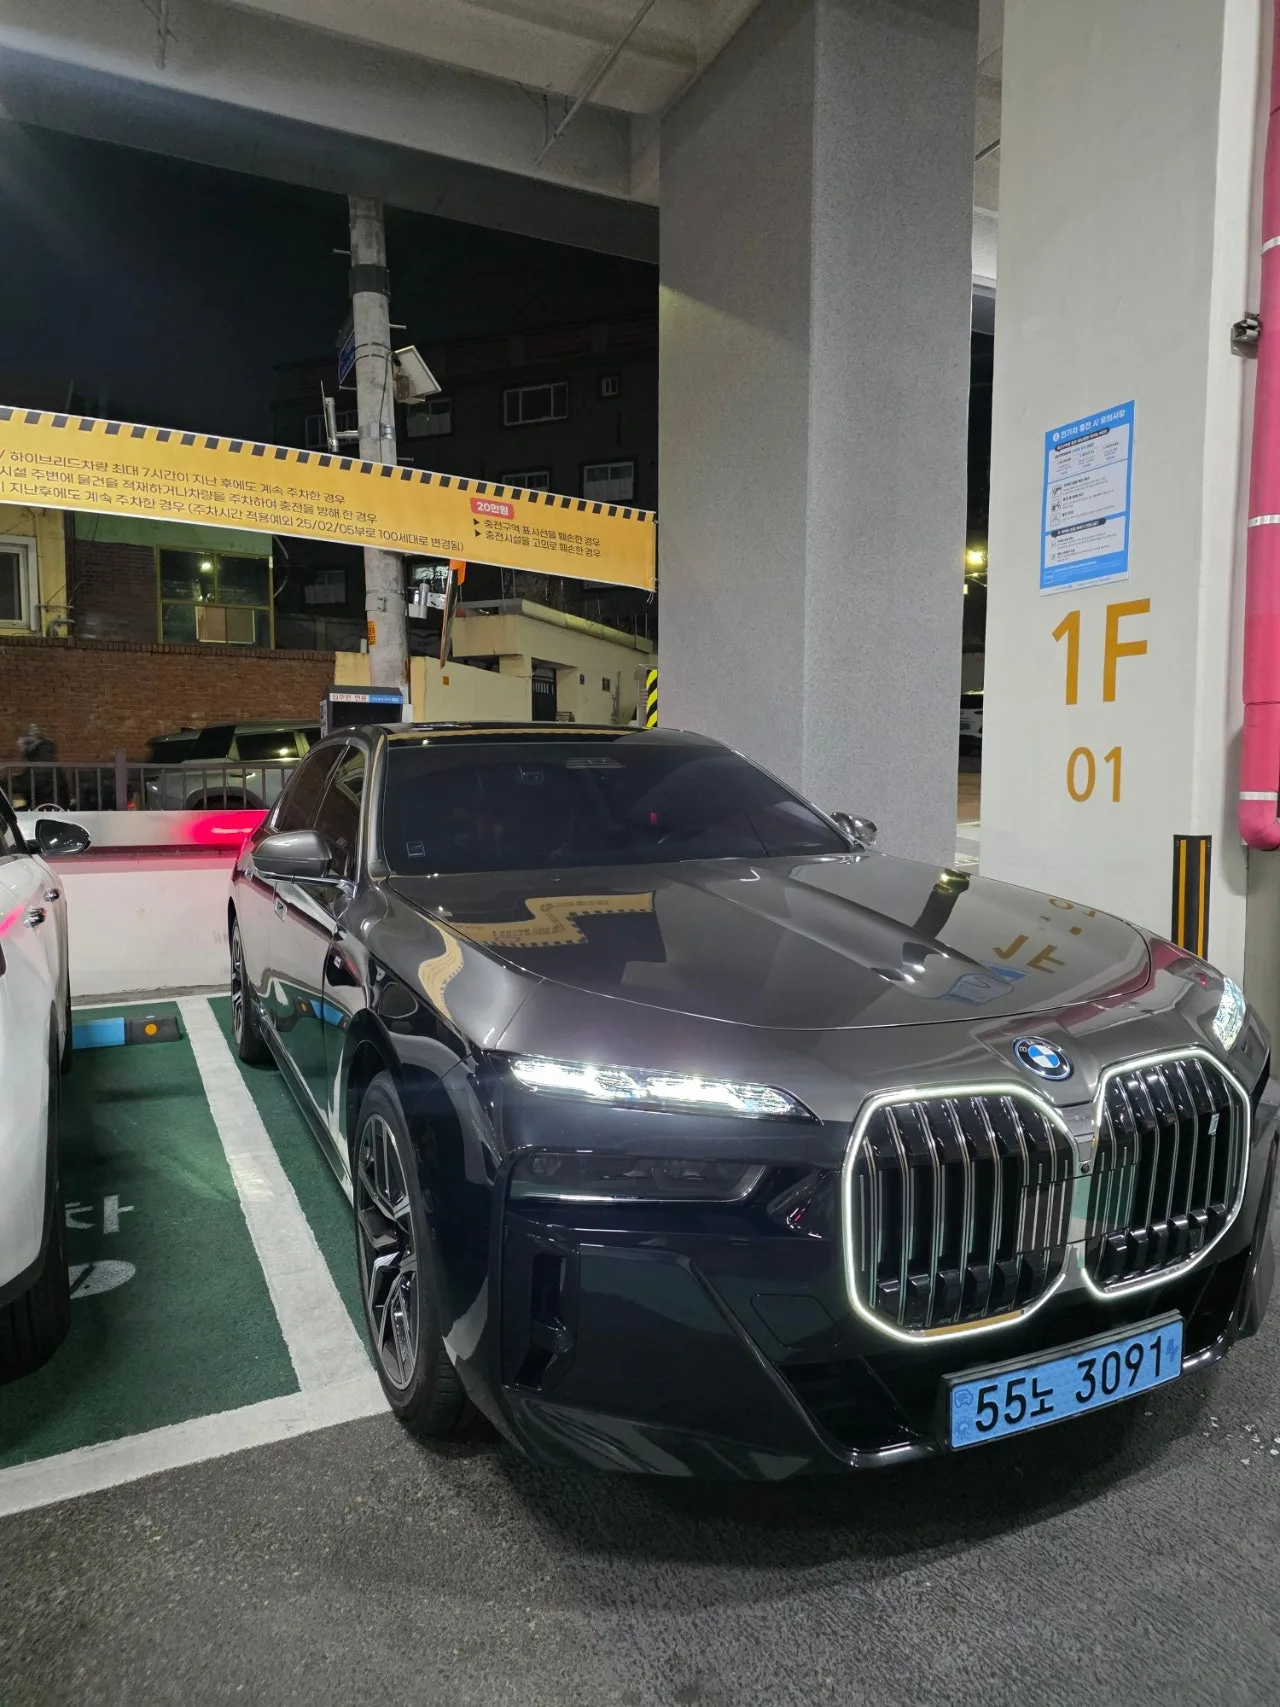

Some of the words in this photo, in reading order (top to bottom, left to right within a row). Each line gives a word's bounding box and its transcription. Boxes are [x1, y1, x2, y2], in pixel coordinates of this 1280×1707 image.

[0, 466, 27, 478] 시설
[31, 469, 74, 484] 주변에
[78, 474, 119, 489] 물건을
[122, 479, 225, 502] 적재하거나차량을
[229, 494, 277, 509] 주차하여
[280, 500, 314, 514] 충전을
[317, 506, 340, 519] 방해
[343, 509, 353, 520] 한
[356, 512, 377, 524] 경우
[10, 451, 108, 472] 하이브리드차량
[112, 463, 139, 476] 최대
[142, 467, 189, 482] 7시간이
[193, 474, 217, 487] 지난
[221, 478, 257, 491] 후에도
[260, 483, 284, 495] 계속
[287, 487, 320, 501] 주차한
[324, 492, 345, 505] 경우
[10, 482, 82, 500] 지난후에도
[86, 491, 112, 504] 계속
[116, 495, 156, 509] 주차한
[160, 500, 185, 513] 경우
[188, 504, 243, 519] (주차시간
[246, 511, 293, 527] 적용예외
[296, 518, 376, 539] 25/02/05부로
[378, 529, 429, 547] 100세대로
[431, 538, 464, 552] 변경됨)
[476, 501, 509, 516] 20만원
[484, 519, 521, 533] 충전구역
[522, 526, 557, 540] 표시선을
[585, 536, 600, 548] 경우
[485, 530, 530, 547] 충전시설을
[532, 538, 557, 551] 고의로
[585, 548, 601, 559] 경우
[1051, 597, 1150, 705] 1F
[1066, 746, 1122, 803] 01
[975, 1375, 1054, 1432] 55노
[1075, 1335, 1162, 1403] 3091
